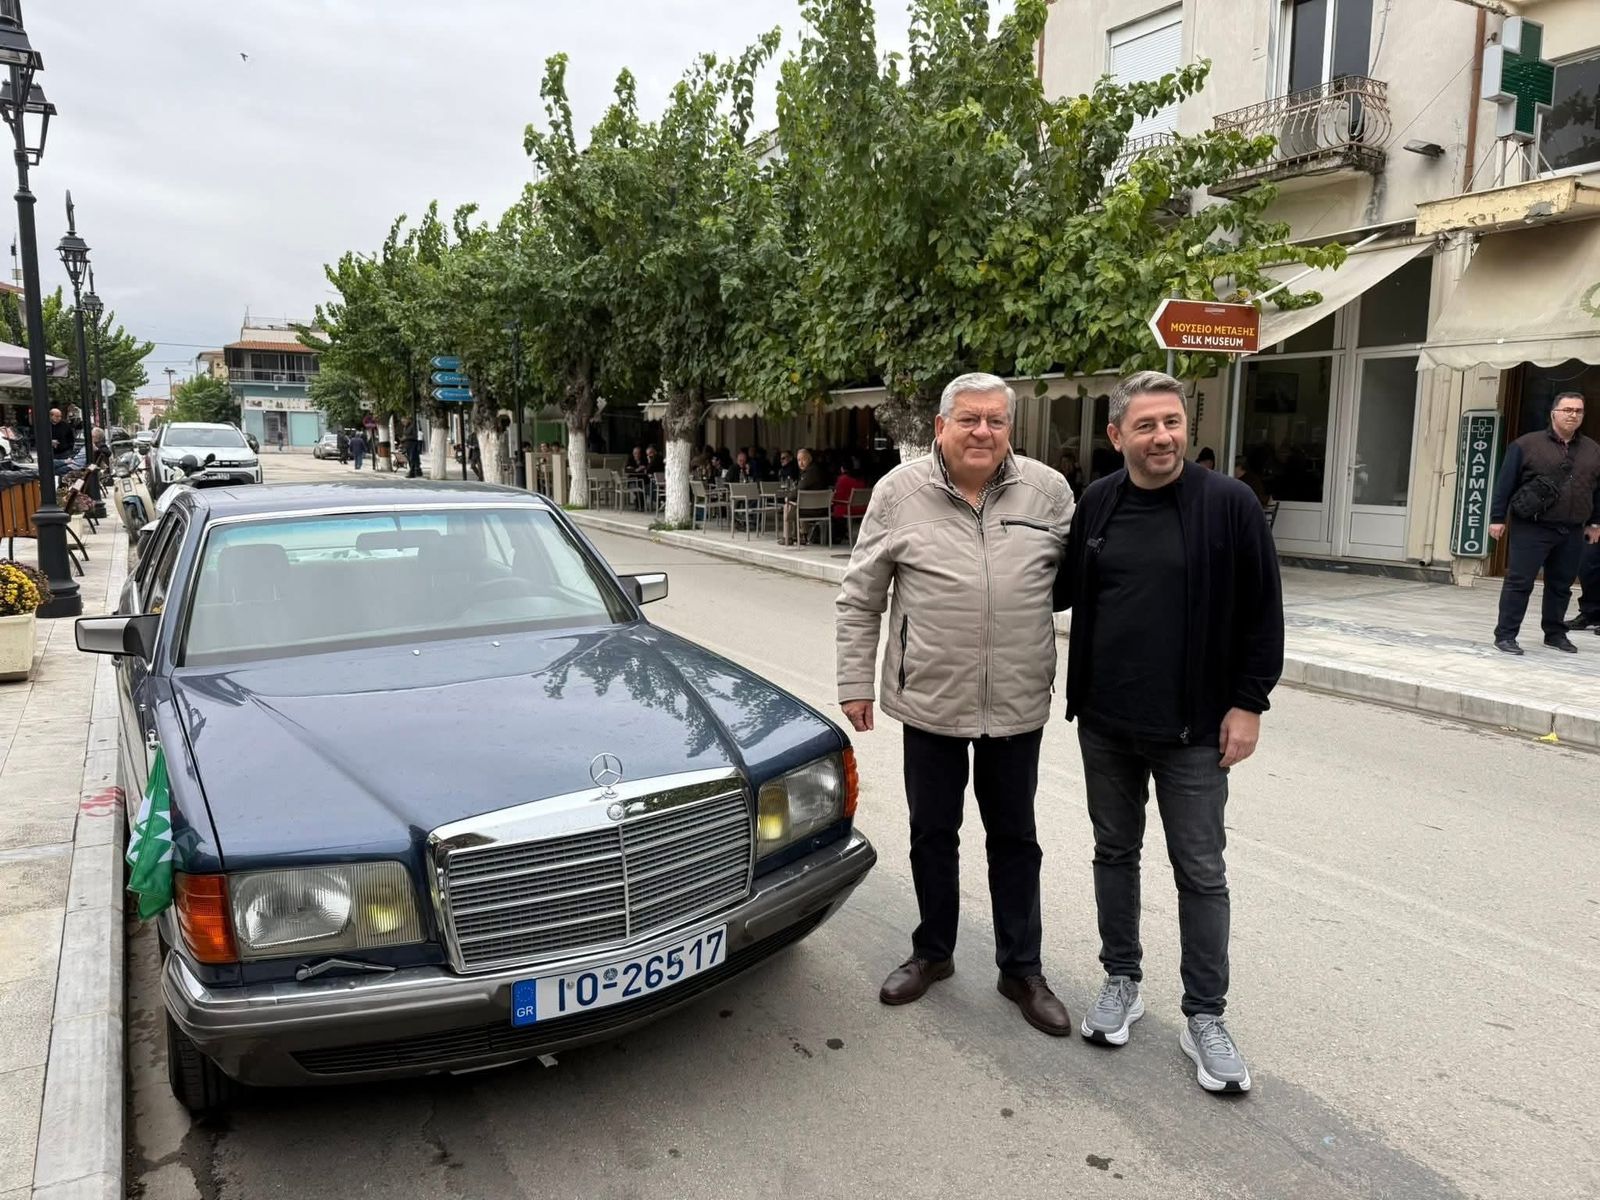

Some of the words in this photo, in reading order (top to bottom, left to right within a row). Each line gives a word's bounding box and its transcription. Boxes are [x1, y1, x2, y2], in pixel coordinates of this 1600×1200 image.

[1171, 322, 1212, 334] ΜΟΥΣΕΙΟ
[1214, 326, 1255, 337] ΜΕΤΑΞΗΣ
[1182, 335, 1202, 345] SILK
[1205, 336, 1244, 347] MUSEUM
[1463, 440, 1488, 552] ΦΑΡΜΑΚΕΙΟ
[516, 1005, 534, 1018] GR
